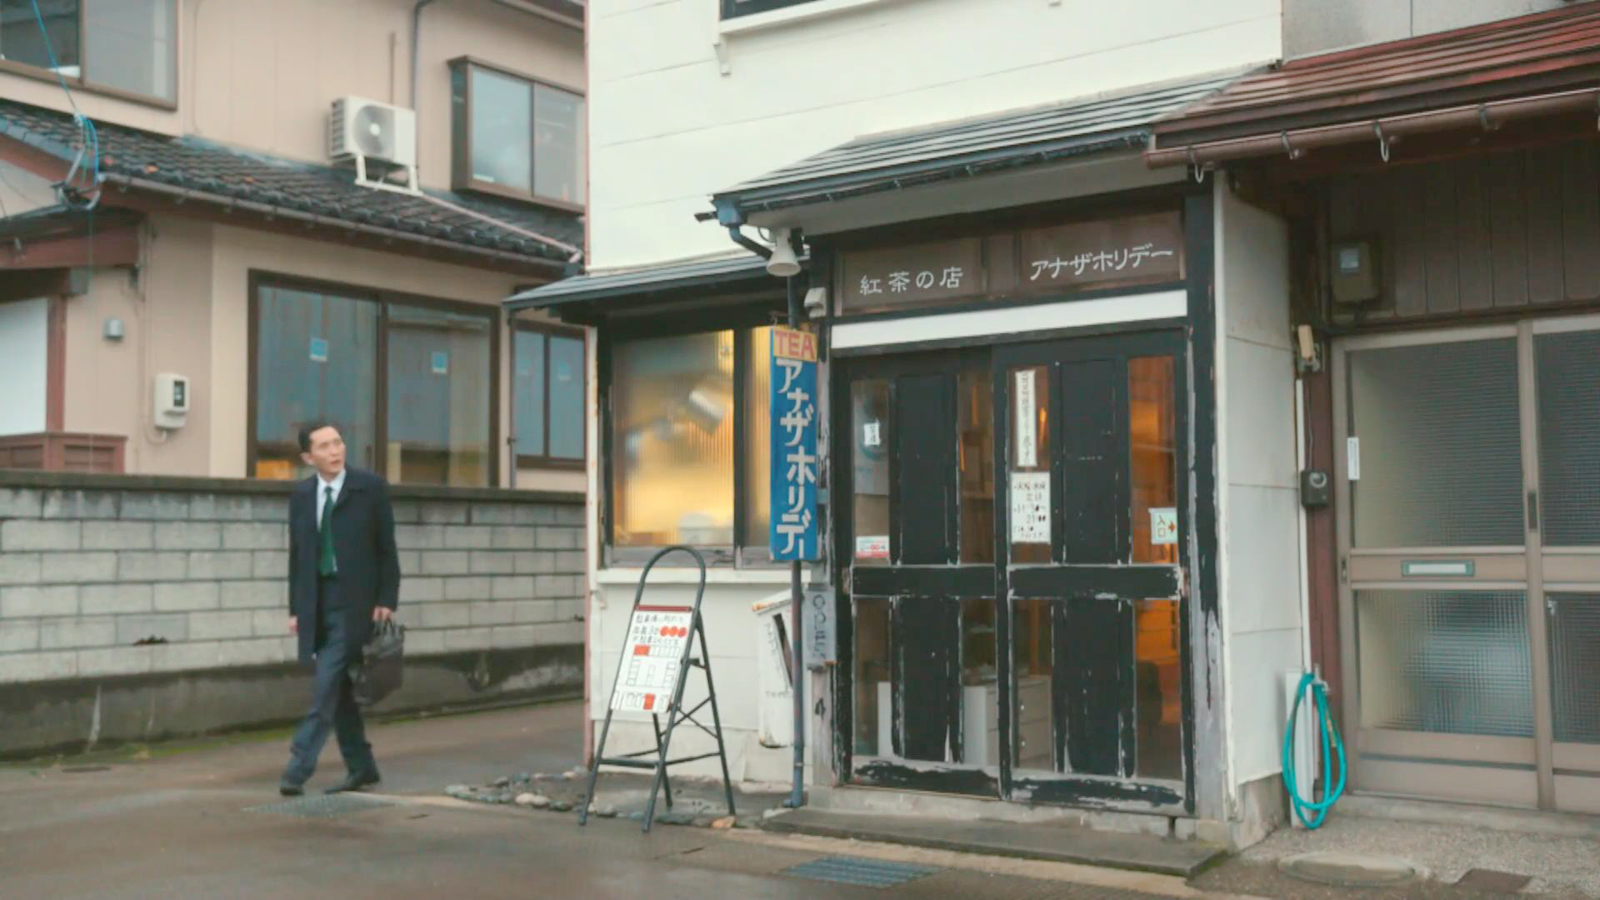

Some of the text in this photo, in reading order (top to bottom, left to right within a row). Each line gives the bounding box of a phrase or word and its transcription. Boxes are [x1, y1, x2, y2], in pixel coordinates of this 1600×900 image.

[1029, 242, 1174, 282] アナザホリデー
[859, 266, 964, 296] 紅茶の店
[774, 330, 816, 360] TEA
[776, 358, 816, 559] アナザホリデー
